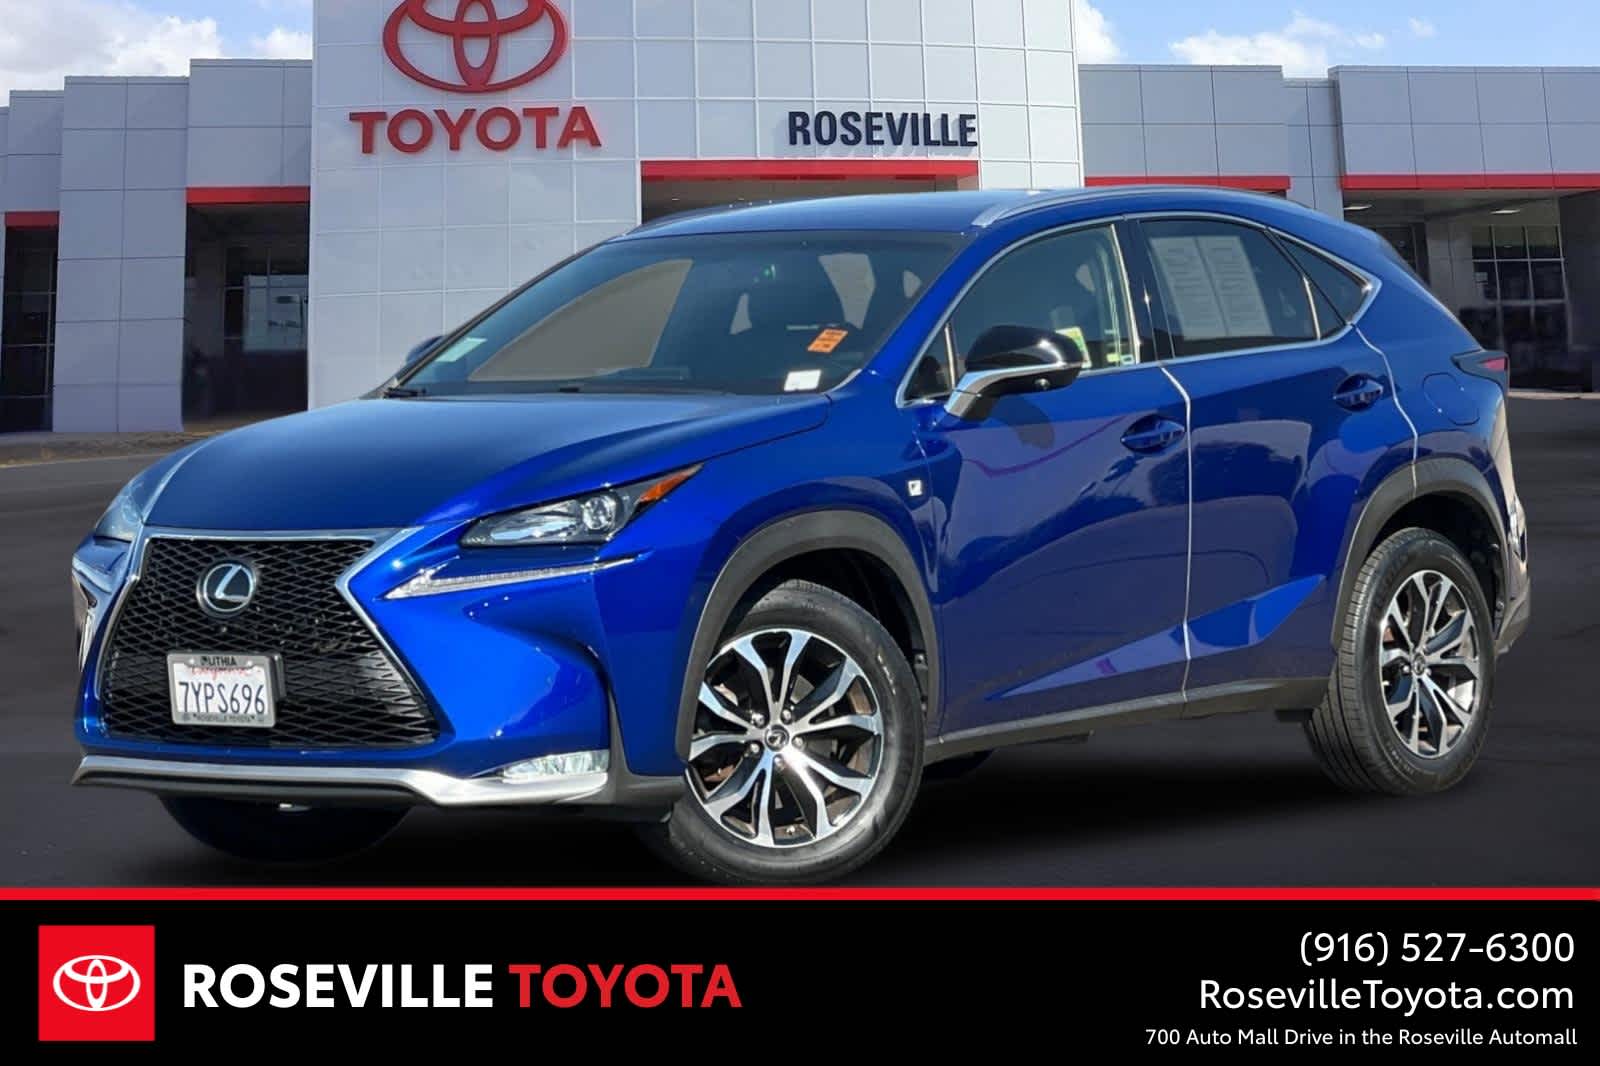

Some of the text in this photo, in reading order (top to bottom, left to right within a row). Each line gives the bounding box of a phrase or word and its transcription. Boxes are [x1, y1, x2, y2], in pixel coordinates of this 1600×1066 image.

[350, 106, 601, 154] TOYOTA
[788, 111, 978, 148] ROSEVILLE
[178, 681, 265, 715] 7YPS696
